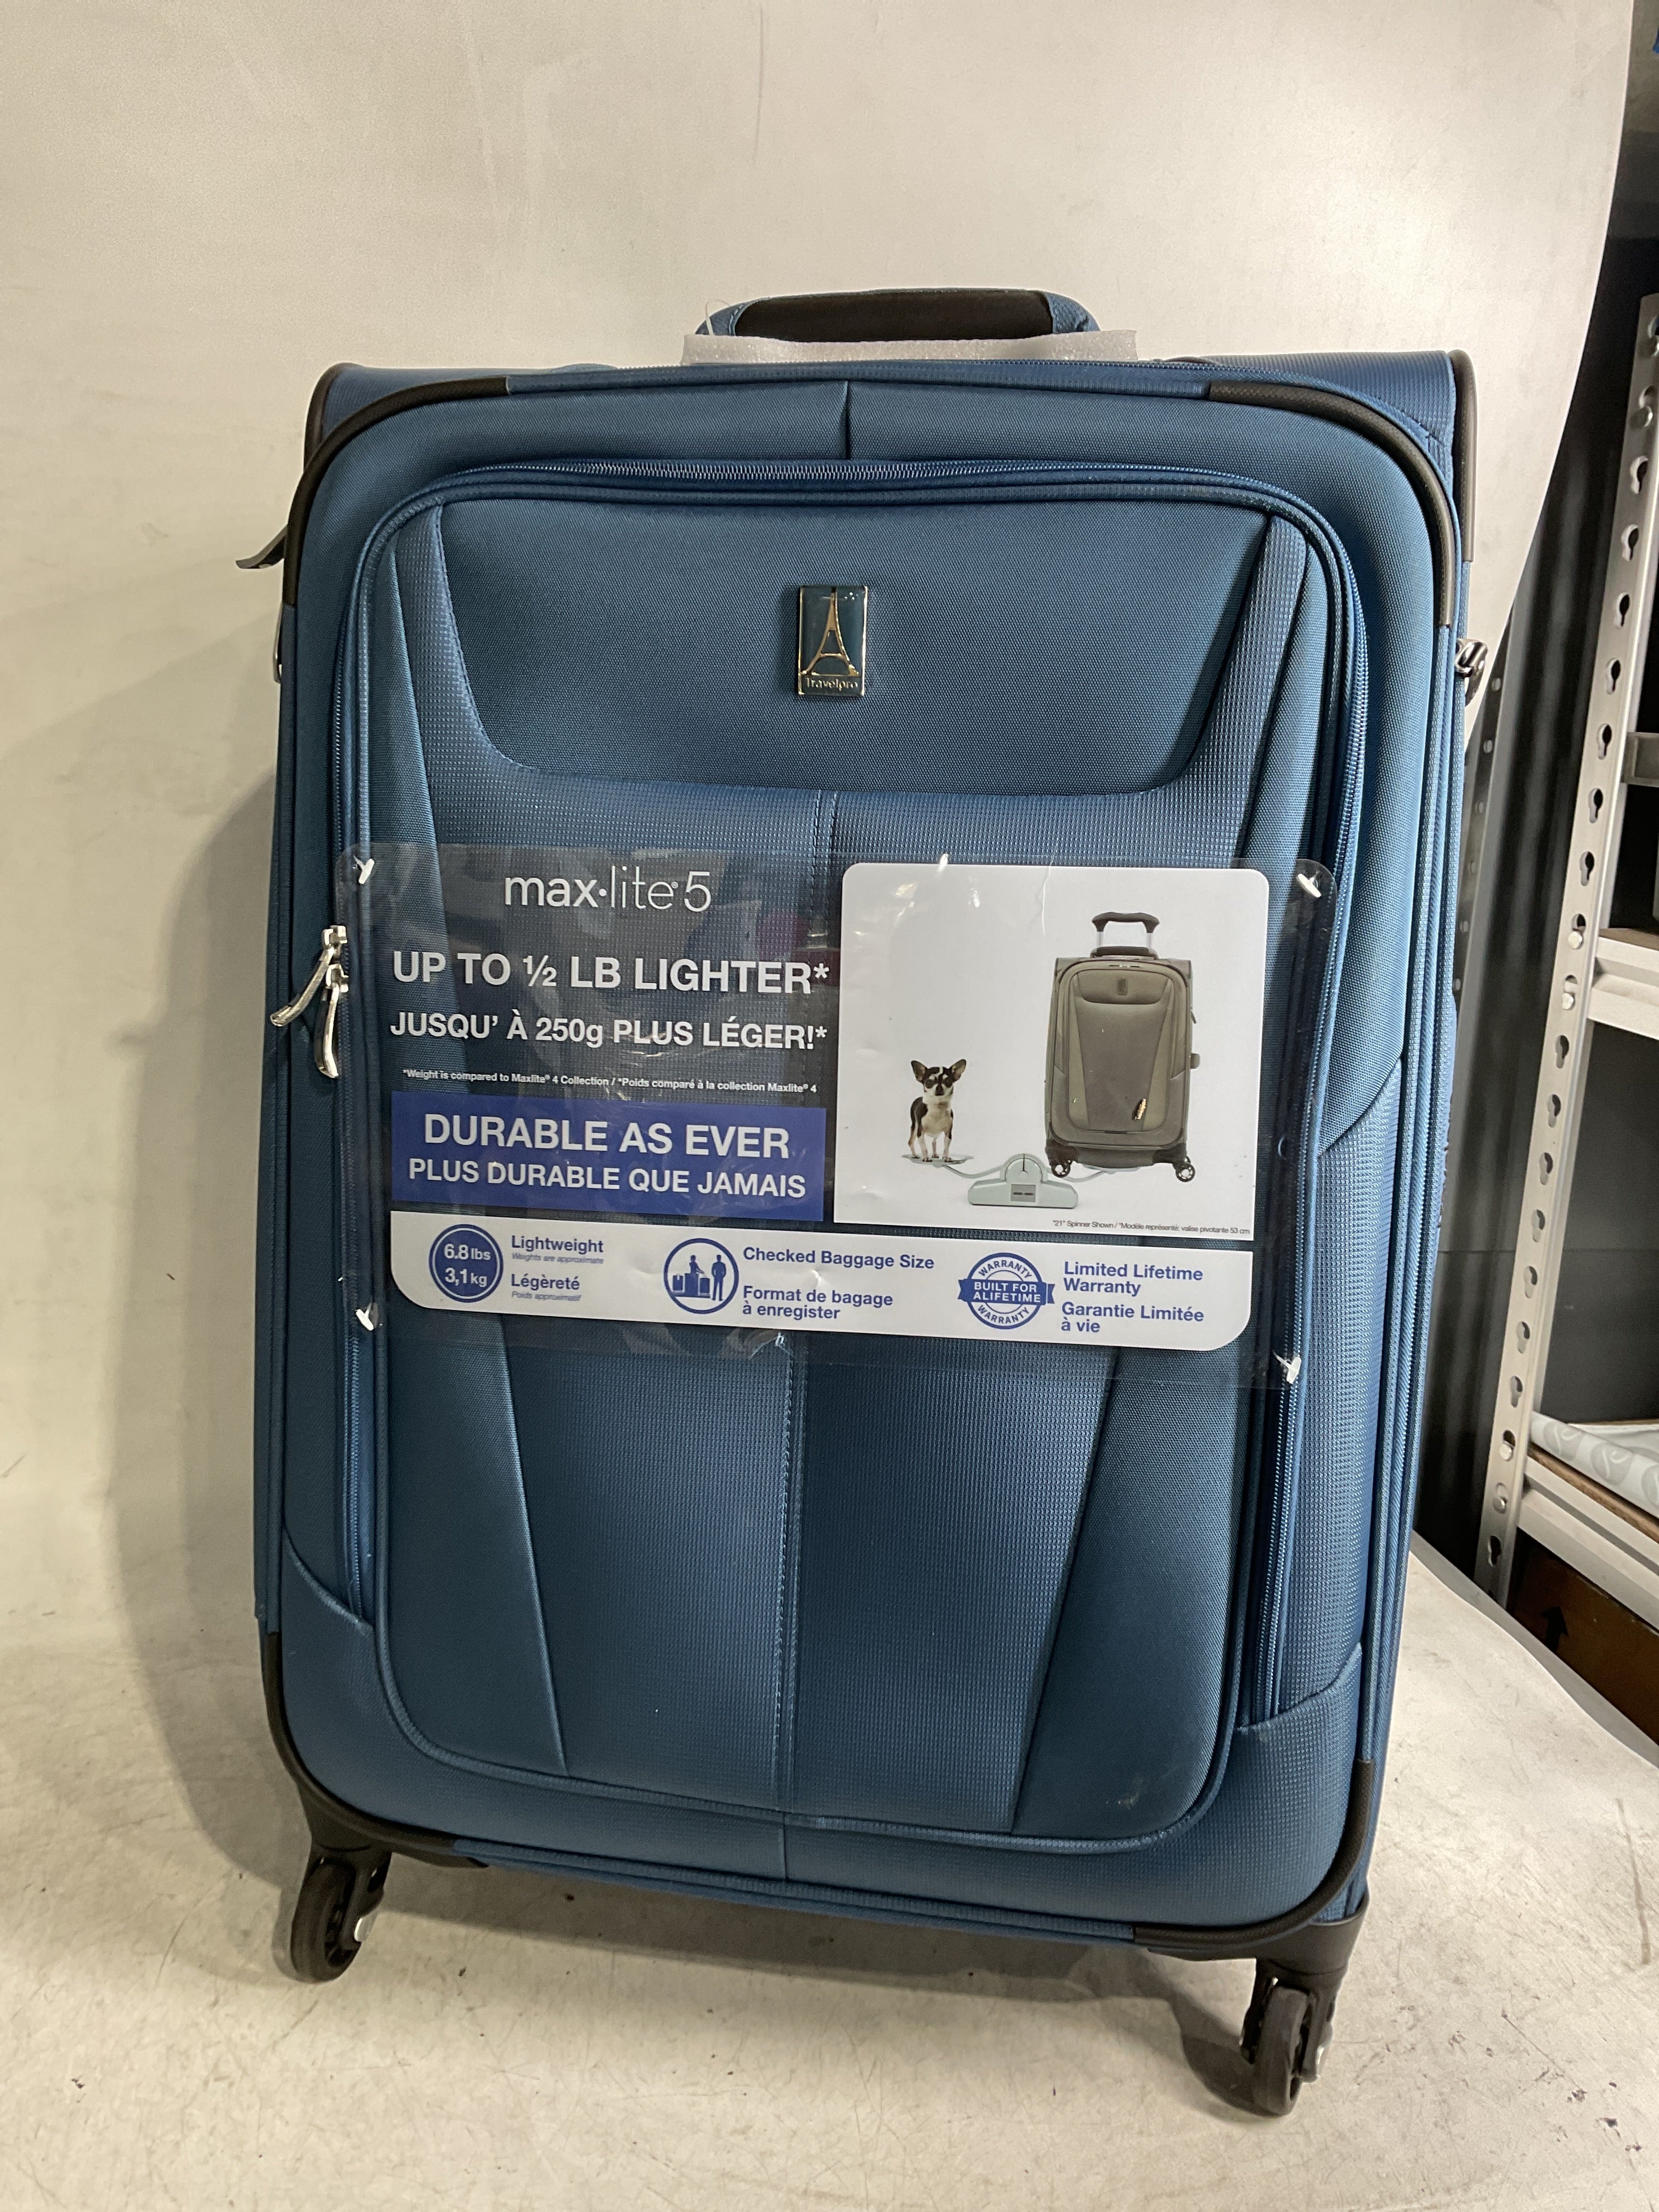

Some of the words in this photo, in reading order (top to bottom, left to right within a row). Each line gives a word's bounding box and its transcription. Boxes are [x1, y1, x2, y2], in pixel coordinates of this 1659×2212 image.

[393, 950, 446, 984] UP
[458, 952, 511, 986] TO
[571, 956, 621, 990] LB
[506, 1009, 528, 1041] À
[535, 1017, 603, 1048] 250g
[613, 1019, 693, 1046] PLUS
[440, 1070, 449, 1079] is
[450, 1071, 497, 1084] compared
[500, 1074, 509, 1082] to
[551, 1076, 558, 1084] 4
[560, 1075, 608, 1086] Collection
[651, 1079, 695, 1091] comparé
[697, 1080, 703, 1090] à
[706, 1081, 715, 1090] la
[717, 1081, 765, 1092] collection
[810, 1085, 817, 1093] 4
[424, 1113, 608, 1153] DURABLE
[619, 1121, 673, 1155] AS
[686, 1124, 790, 1159] EVER
[409, 1158, 479, 1183] PLUS
[487, 1161, 620, 1190] DURABLE
[628, 1167, 690, 1194] QUE
[697, 1170, 806, 1199] JAMAIS
[511, 1235, 604, 1255] Lightweight
[512, 1252, 541, 1262] Weights
[743, 1246, 816, 1263] Checked
[821, 1250, 894, 1270] Baggage
[899, 1254, 935, 1269] Size
[978, 1259, 1032, 1279] WARRANTY
[1064, 1261, 1128, 1278] Limited
[1133, 1263, 1204, 1281] Lifetime
[511, 1273, 580, 1291] Légèreté
[974, 1281, 1009, 1292] BUILT
[1012, 1283, 1037, 1293] FOR
[1063, 1277, 1142, 1297] Warranty
[743, 1285, 801, 1302] Format
[806, 1289, 826, 1303] de
[832, 1290, 894, 1308] bagage
[742, 1301, 752, 1315] à
[757, 1304, 841, 1321] enregister
[977, 1304, 1030, 1324] WARRANTY
[1061, 1301, 1135, 1319] Garantie
[1140, 1305, 1205, 1322] Limitée
[1061, 1317, 1071, 1331] à
[1076, 1318, 1101, 1333] vie
